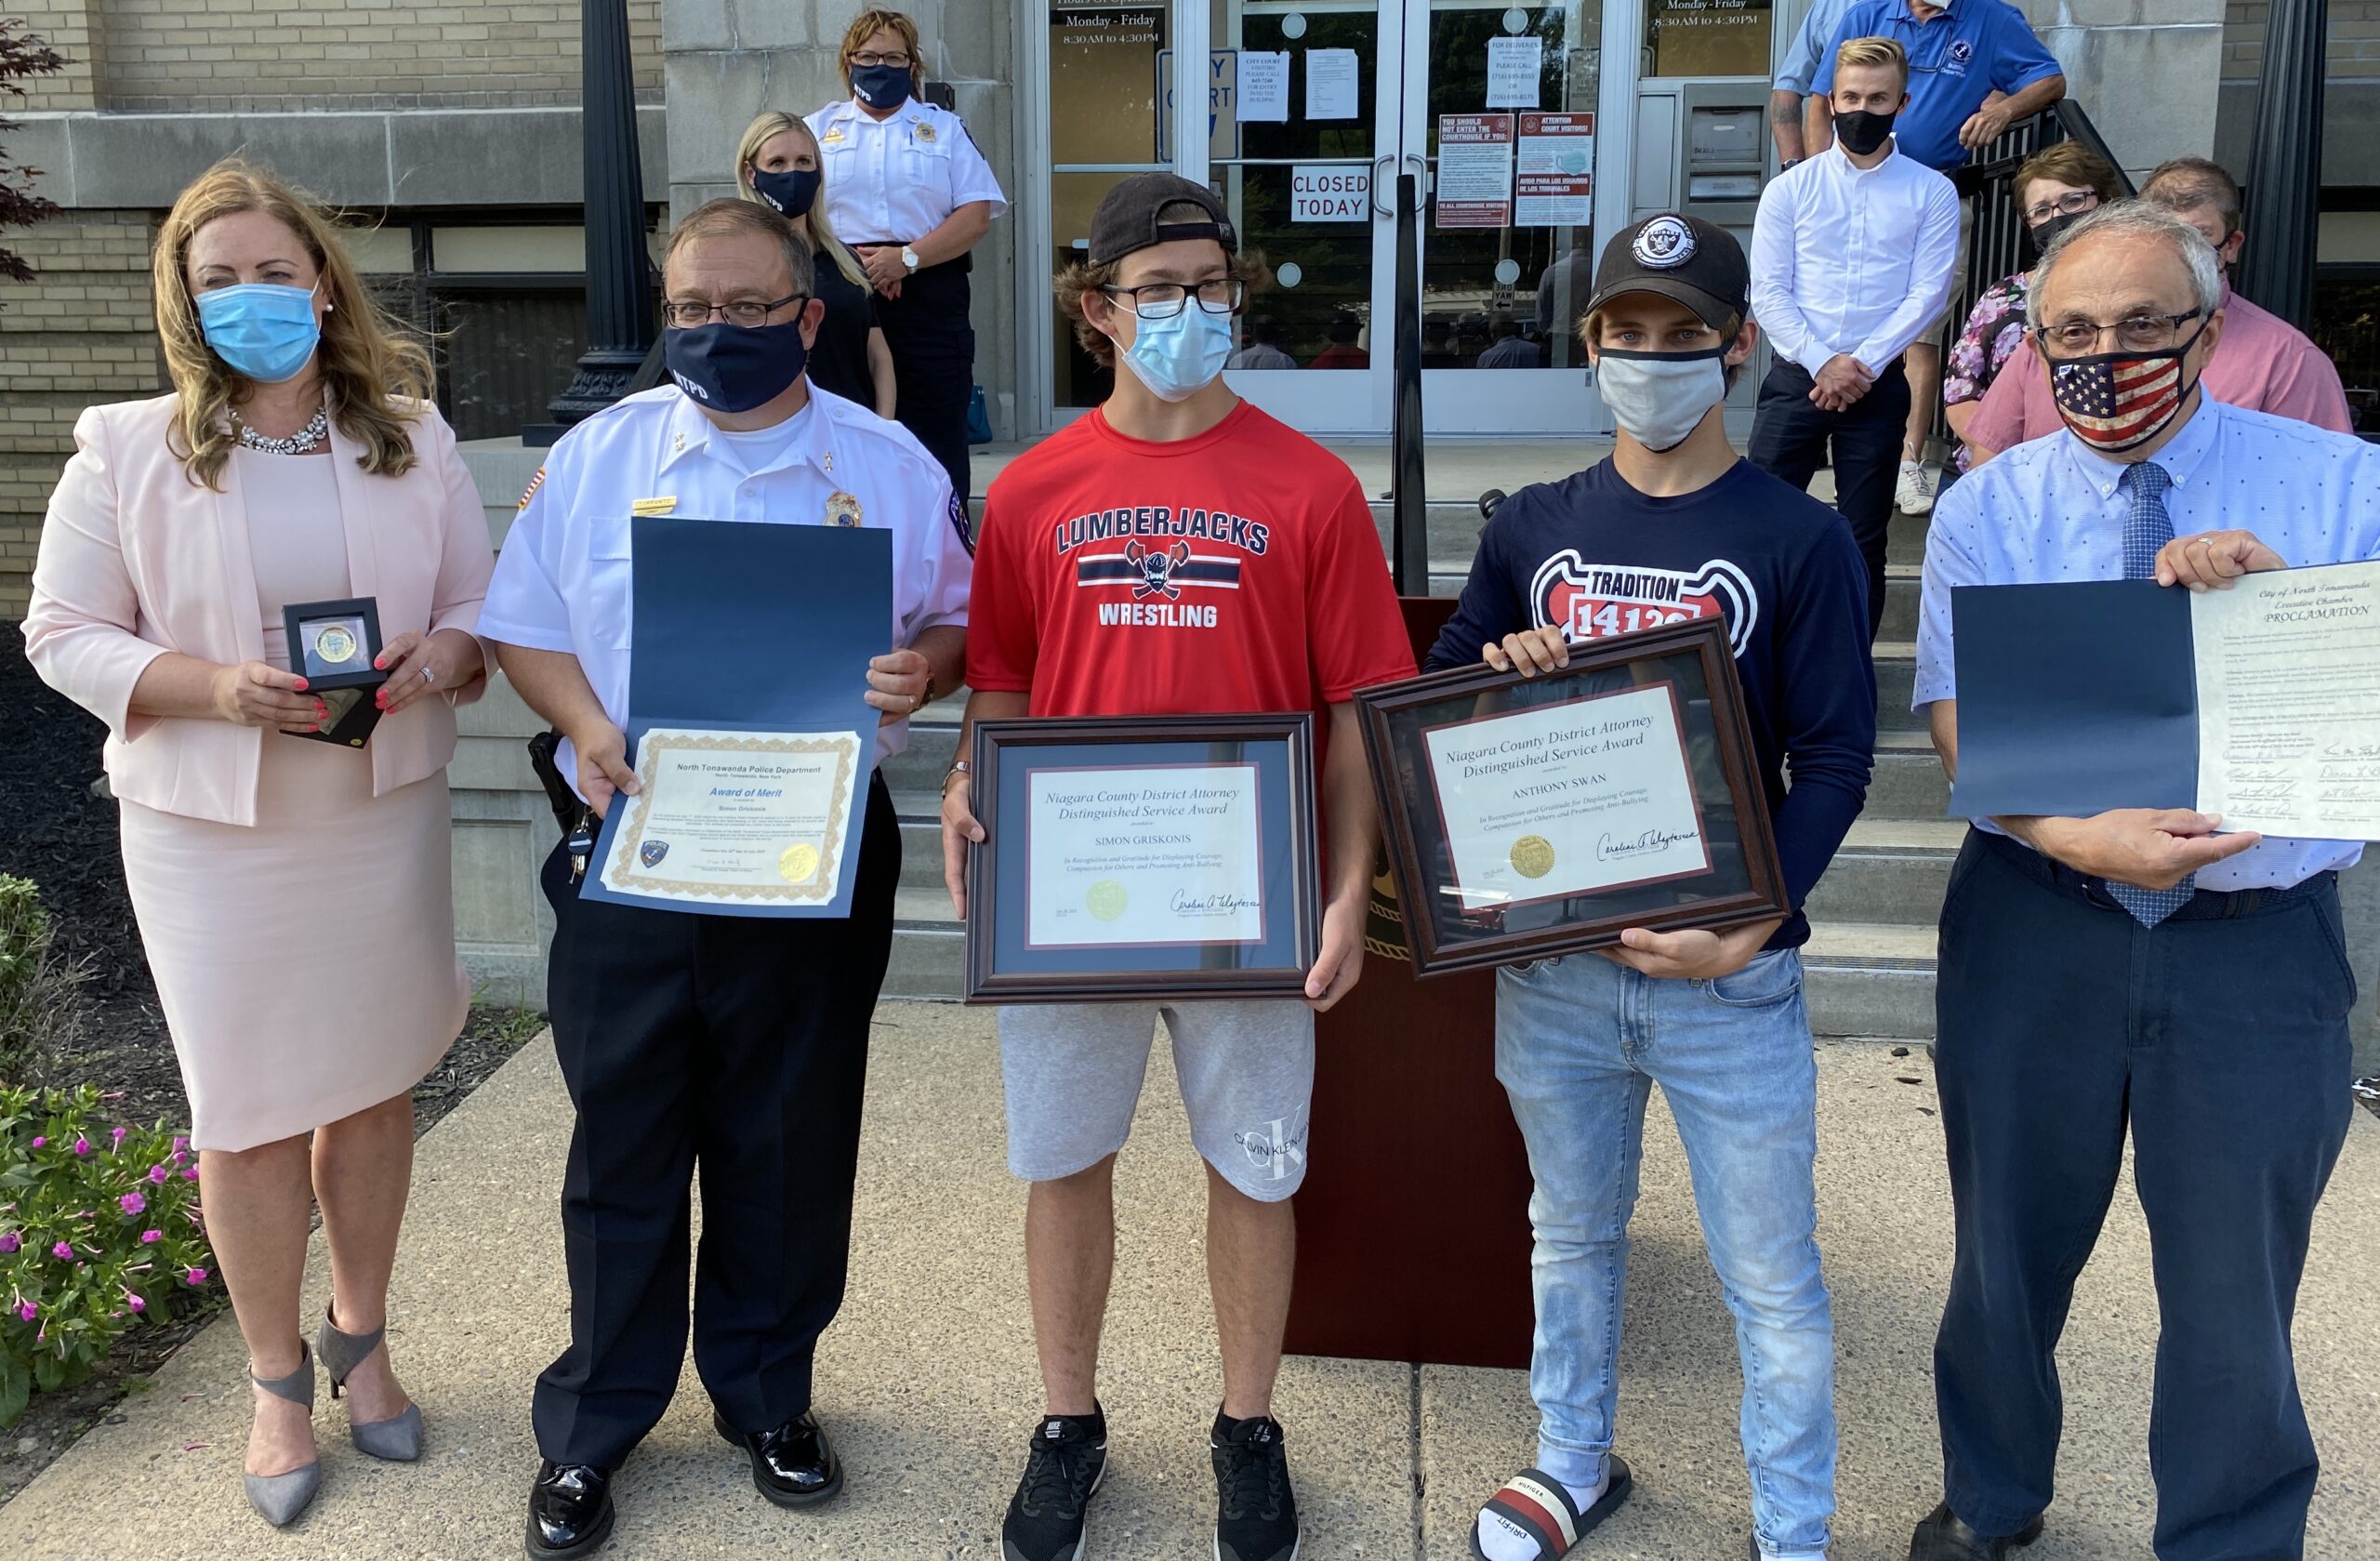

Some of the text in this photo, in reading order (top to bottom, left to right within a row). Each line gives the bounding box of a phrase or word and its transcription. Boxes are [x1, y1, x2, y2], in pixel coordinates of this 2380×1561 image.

[1668, 0, 1707, 11] Monday
[1715, 0, 1747, 10] Friday
[1066, 15, 1111, 29] Monday
[1121, 14, 1156, 28] Friday
[1701, 17, 1712, 26] to
[1106, 34, 1116, 43] to
[854, 84, 871, 101] NTPD
[1293, 176, 1368, 192] CLOSED
[763, 192, 783, 212] NTPD
[1297, 199, 1363, 216] TODAY
[673, 369, 708, 399] NTPD
[1056, 506, 1270, 556] LUMBERJACKS
[1592, 571, 1680, 602] TRADITION
[2259, 580, 2371, 599] City of North Tonawanda
[2274, 596, 2354, 609] Executive Chamber
[1099, 603, 1217, 628] WRESTLING
[2264, 605, 2372, 624] PROCLAMATION
[1447, 715, 1654, 764] Niagara County District Attorney
[1463, 733, 1644, 778] Distinguished Service Award
[702, 764, 747, 773] Tonawanda
[709, 787, 783, 798] Award of Merit
[1513, 774, 1607, 800] ANTHONY SWAN
[1045, 787, 1240, 806] Niagara County District Attorney
[1058, 803, 1228, 821] Distinguished Service Award
[1484, 795, 1649, 832] Compassion for Others and Promoting Anti-Bullying
[1488, 810, 1526, 824] Recognition
[1527, 806, 1539, 815] and
[1540, 801, 1570, 813] Gratitude
[1570, 799, 1581, 808] for
[1582, 793, 1618, 805] Displaying
[1095, 834, 1191, 846] SIMON GRISKONIS
[1072, 855, 1108, 864] Recognition
[1162, 853, 1195, 862] Displaying
[1148, 862, 1181, 870] Promoting
[1234, 1132, 1297, 1156] CALVIN KLEIN
[1518, 1481, 1544, 1498] HILFIGER
[1497, 1516, 1527, 1540] DRI-FIT
